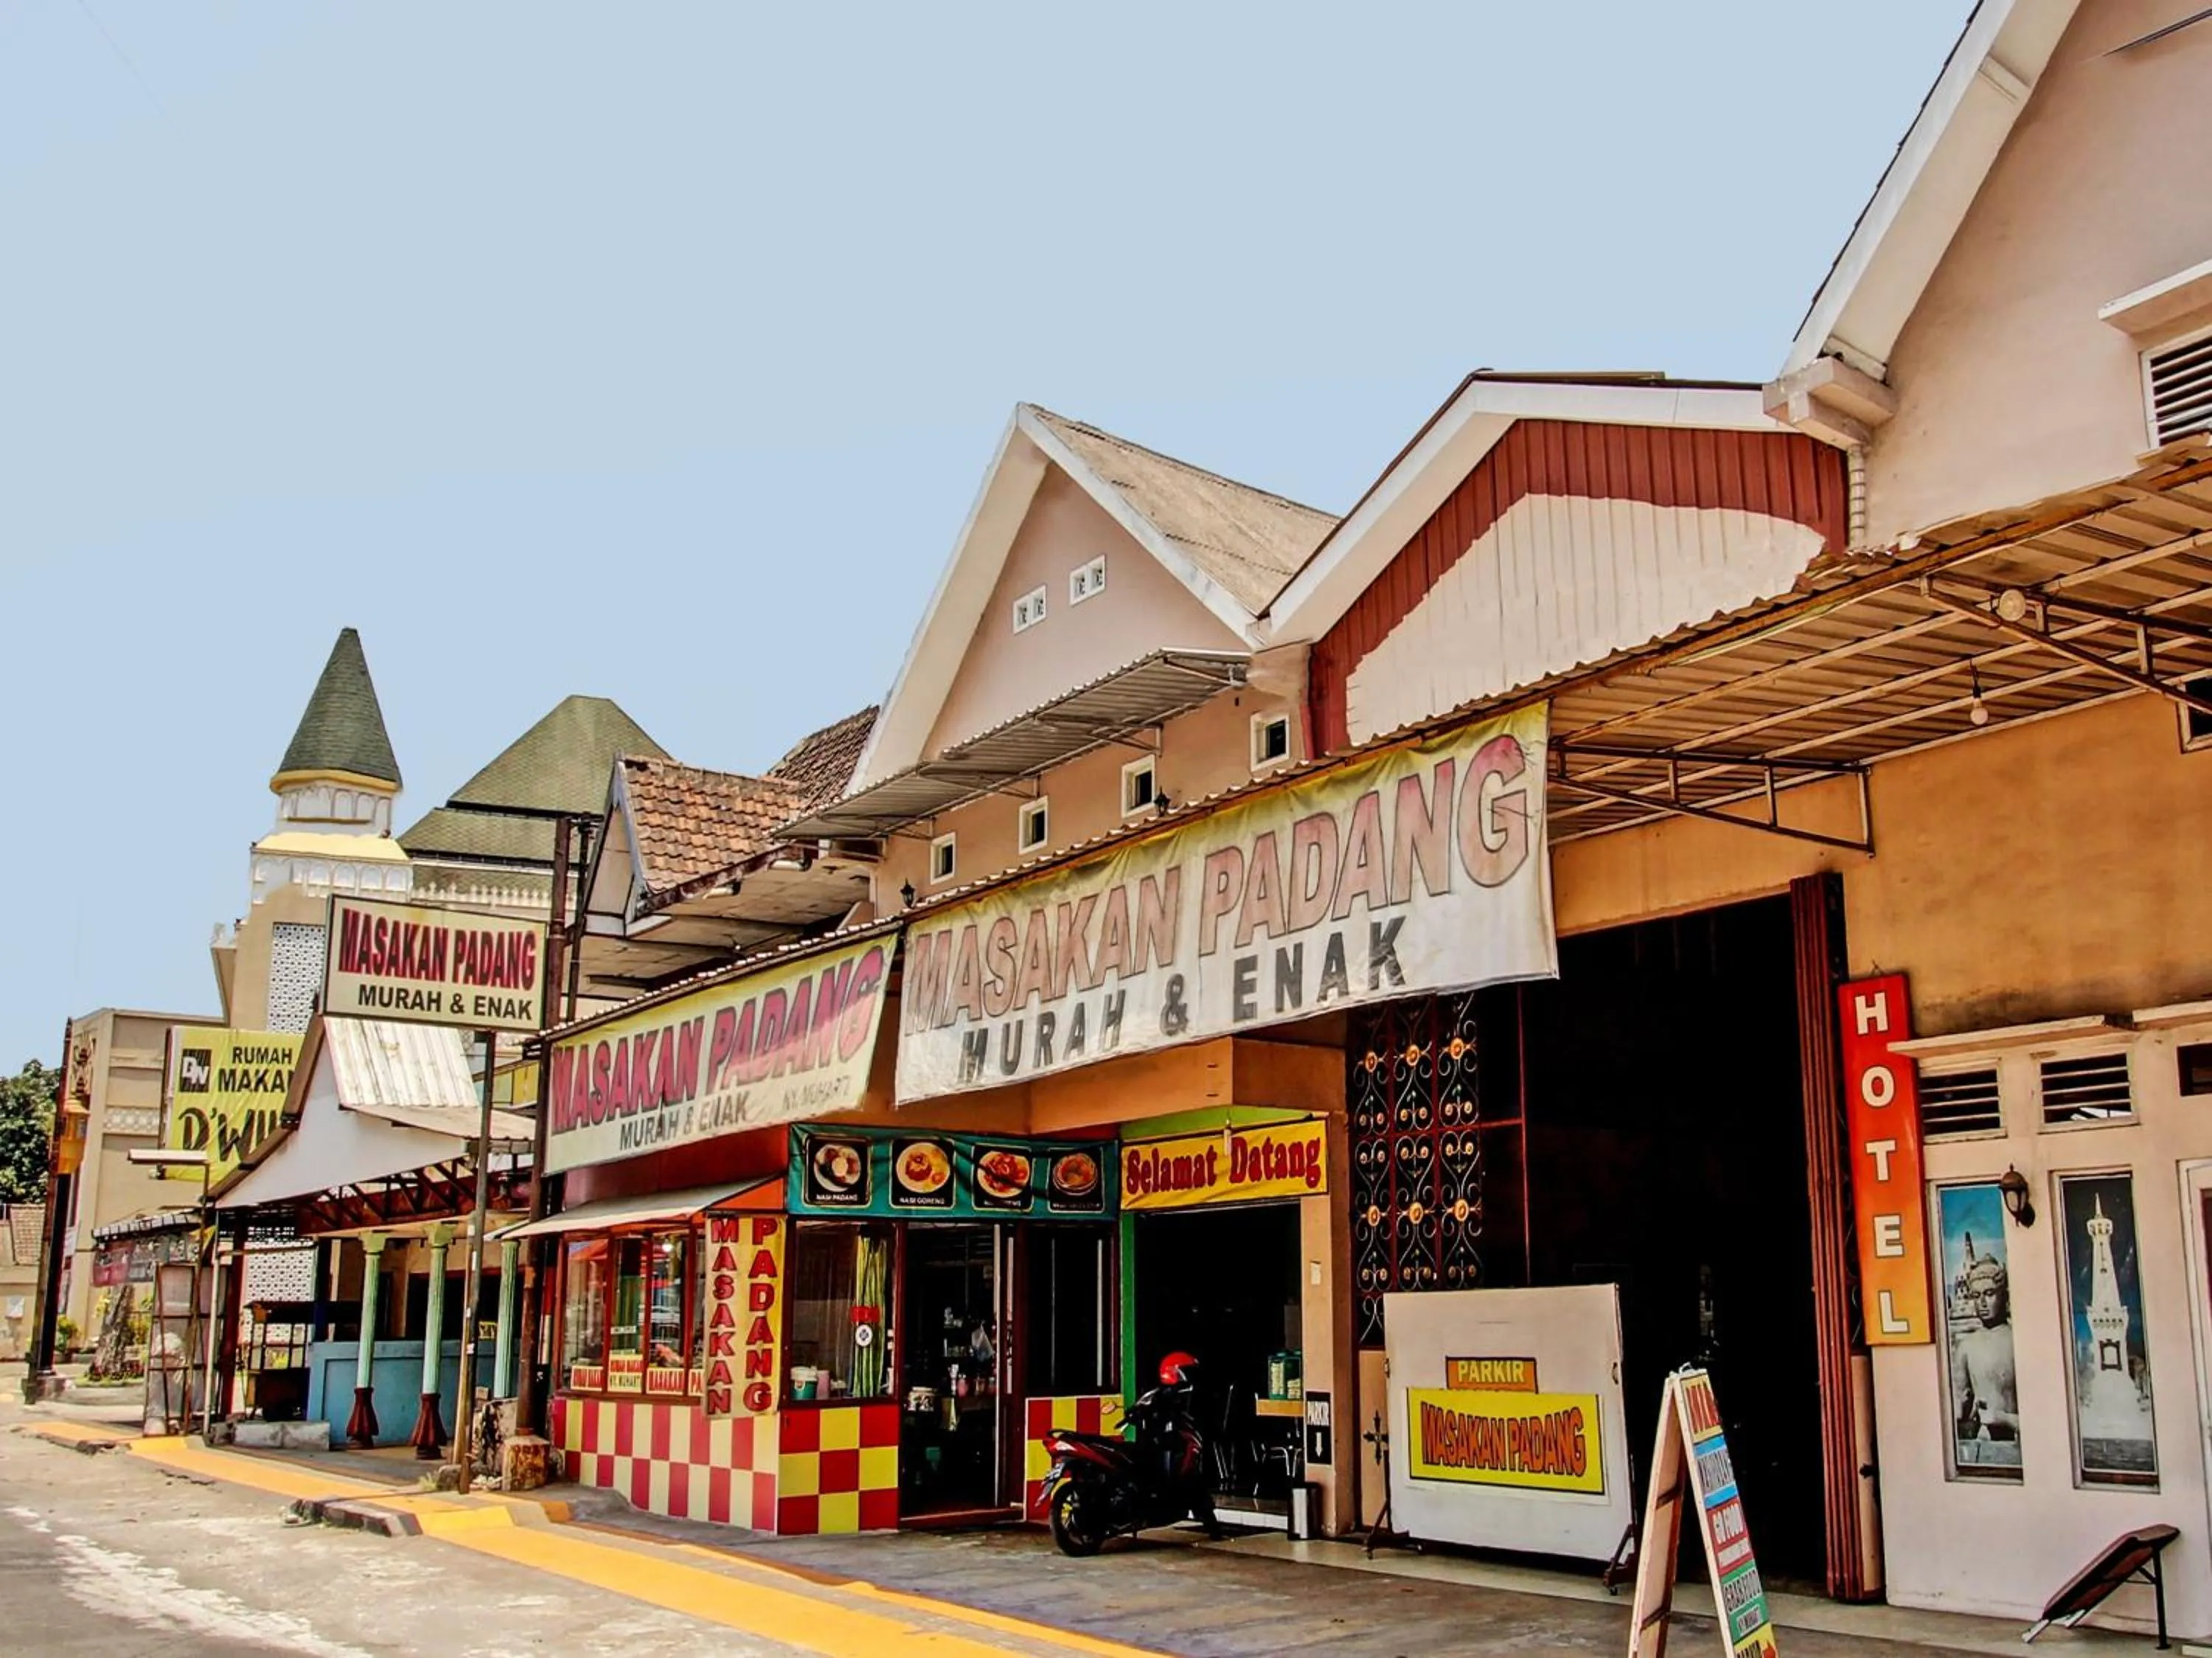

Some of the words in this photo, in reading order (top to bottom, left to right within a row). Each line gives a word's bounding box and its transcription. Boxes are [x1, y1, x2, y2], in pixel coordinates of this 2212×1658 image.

[906, 867, 1179, 1037] MASAKAN
[1199, 734, 1528, 957] PADANG
[338, 908, 448, 982] MASAKAN
[452, 929, 536, 991] PADANG
[358, 984, 442, 1012] MURAH
[450, 993, 465, 1014] &
[473, 995, 532, 1020] ENAK
[551, 1016, 703, 1135] MASAKAN
[707, 945, 884, 1094] PADANG
[959, 989, 1126, 1084] MURAH
[1160, 974, 1189, 1036] &
[1232, 915, 1407, 1023] ENAK
[232, 1046, 292, 1064] RUMAH
[620, 1108, 678, 1151] MURAH
[683, 1106, 694, 1134] &
[700, 1091, 750, 1131] ENAK
[1126, 1145, 1218, 1195] Selamat
[1229, 1135, 1322, 1189] Datang
[1854, 991, 1910, 1335] HOTEL
[706, 1217, 739, 1415] MASAKAN
[743, 1217, 779, 1412] PADANG
[1458, 1360, 1526, 1384] PARKIR
[1421, 1400, 1506, 1471] MASAKAN
[1507, 1406, 1587, 1477] PADANG
